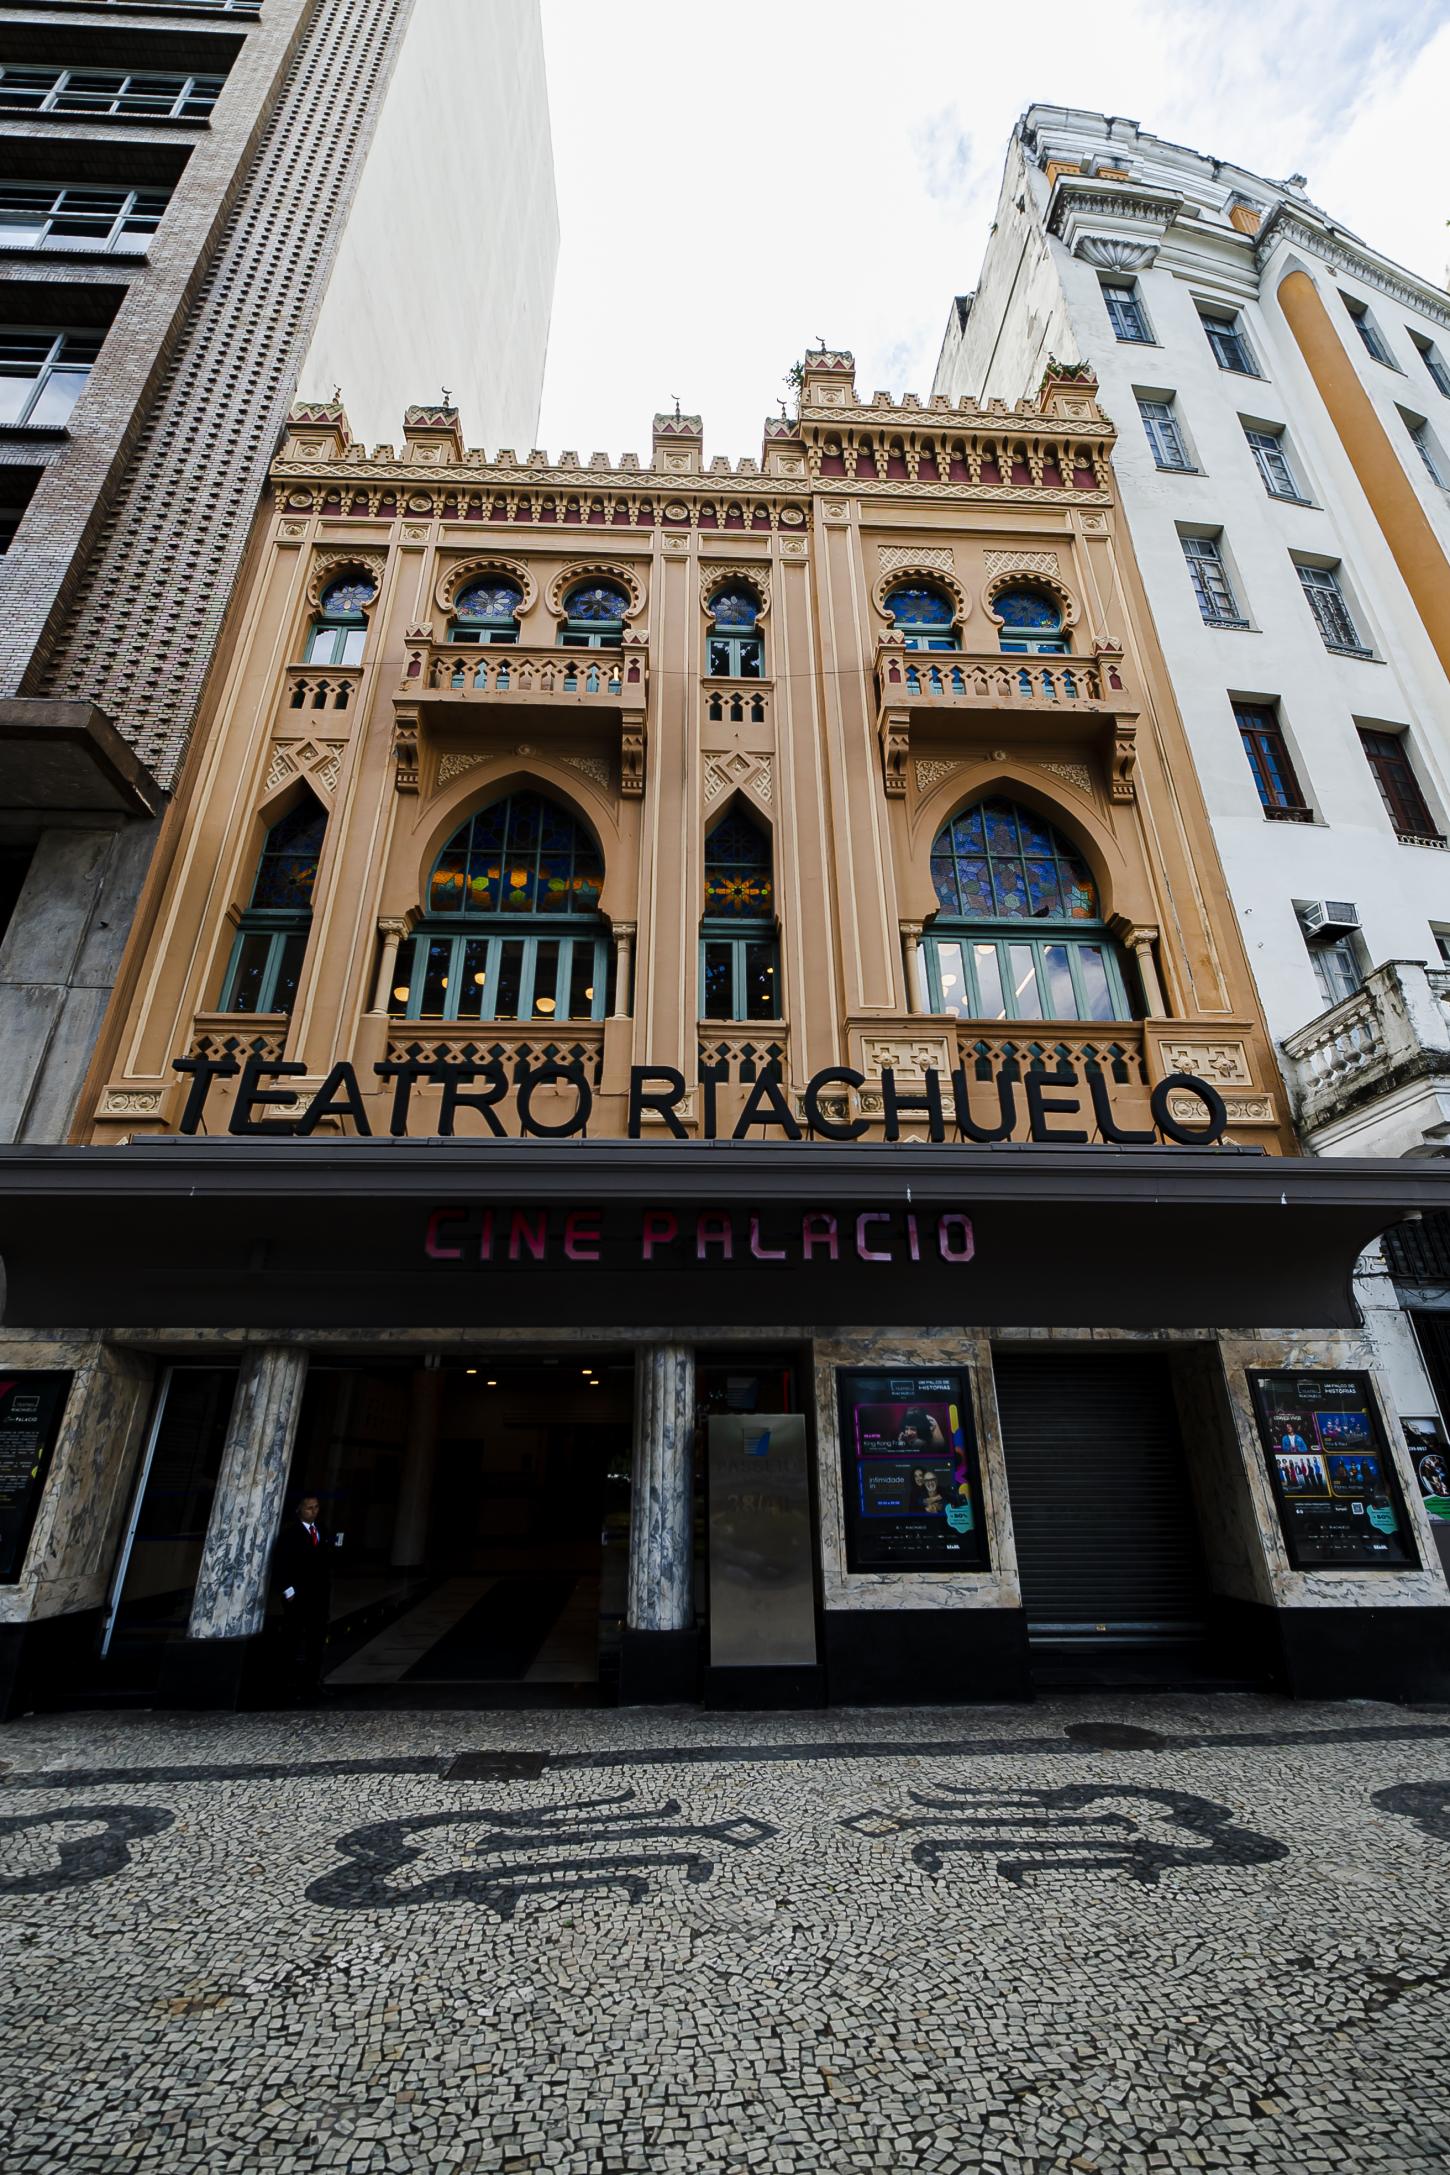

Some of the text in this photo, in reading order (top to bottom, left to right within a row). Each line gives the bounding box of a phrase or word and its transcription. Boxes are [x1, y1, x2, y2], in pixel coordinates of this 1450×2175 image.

[171, 1059, 1228, 1146] TEATRO RIACHUELO
[425, 1209, 975, 1264] CINE PALACIO
